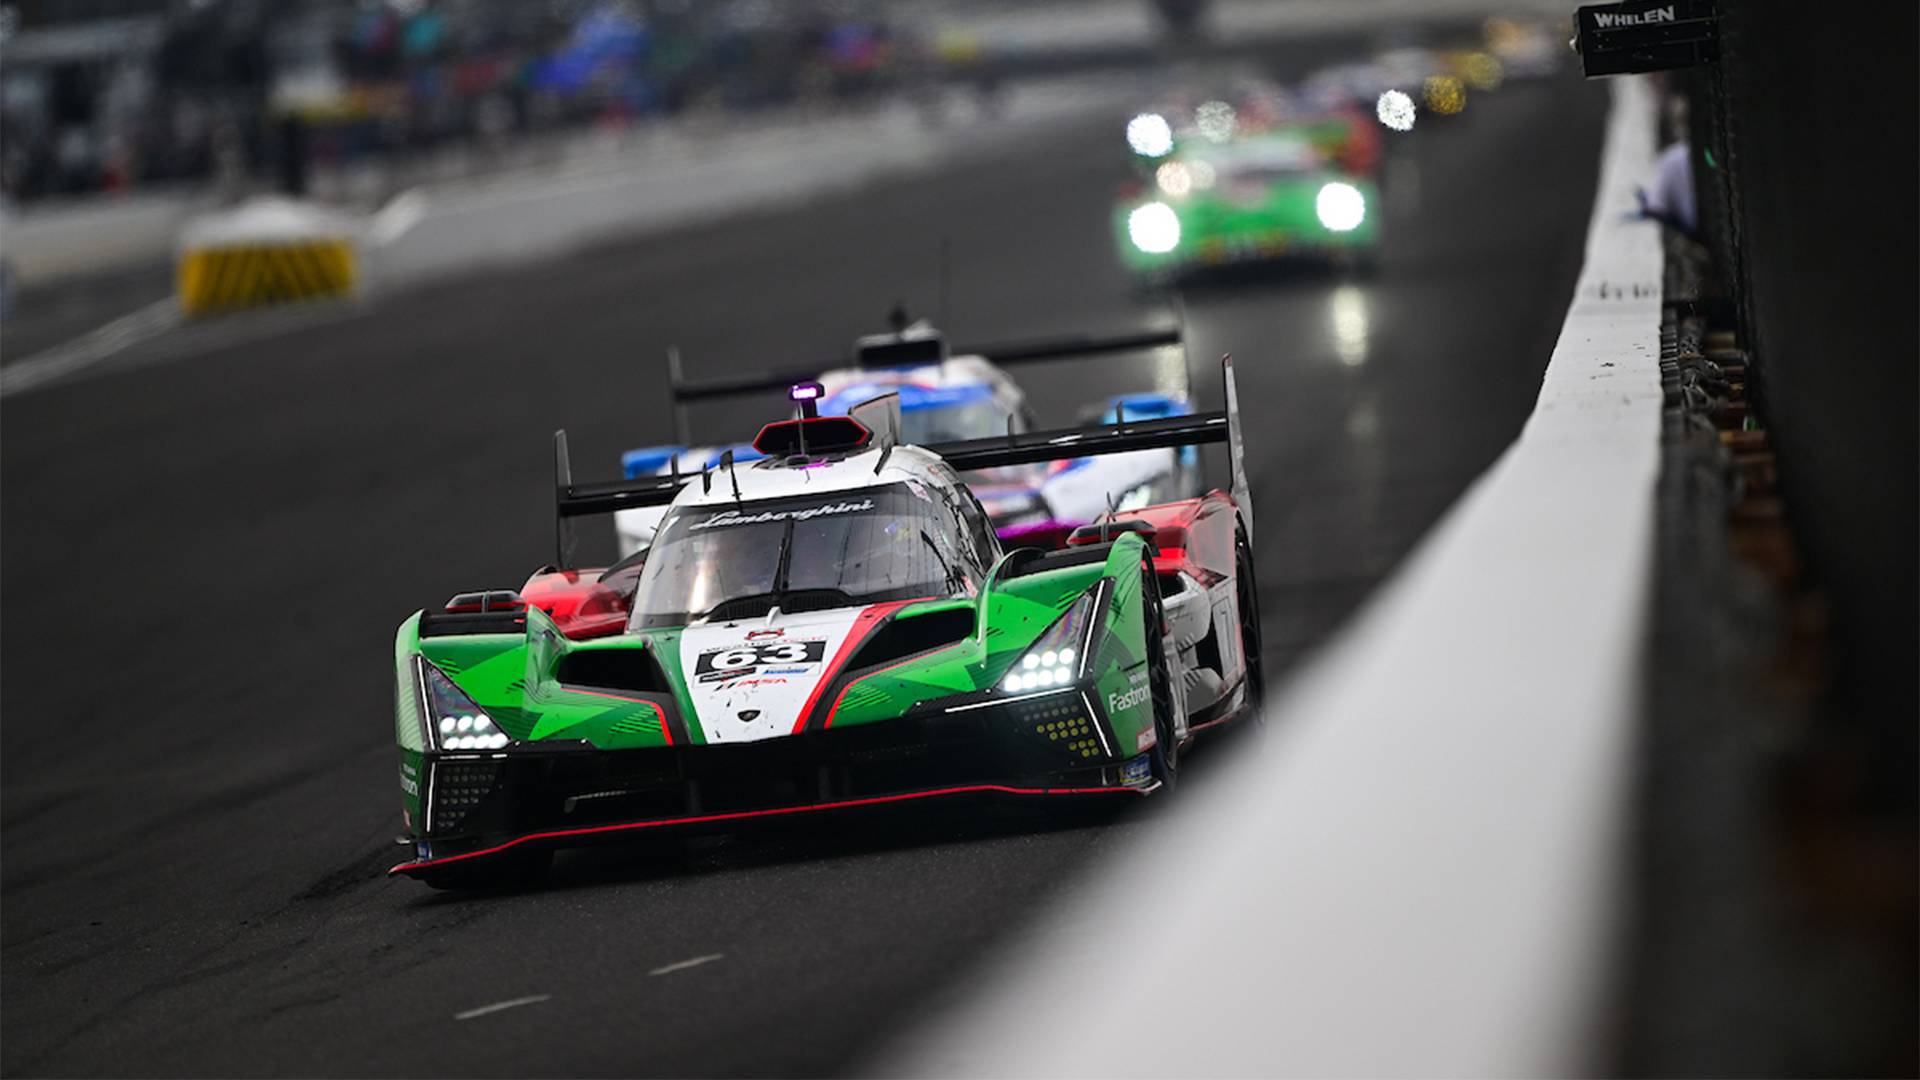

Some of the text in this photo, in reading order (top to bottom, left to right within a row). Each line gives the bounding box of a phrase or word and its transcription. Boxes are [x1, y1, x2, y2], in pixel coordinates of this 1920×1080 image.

[690, 500, 874, 530] Lamborghini
[711, 643, 808, 670] 63
[1108, 685, 1151, 714] Fastron
